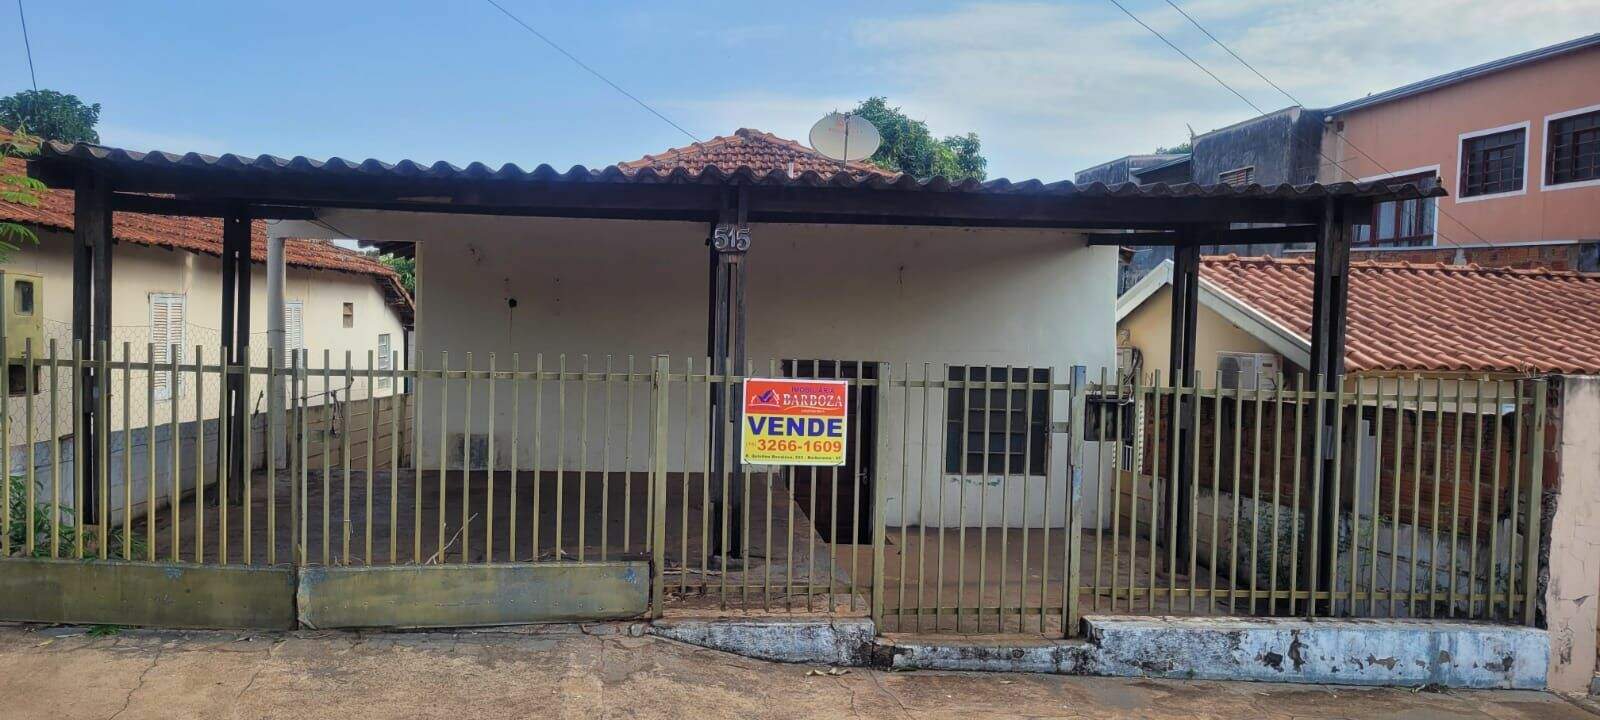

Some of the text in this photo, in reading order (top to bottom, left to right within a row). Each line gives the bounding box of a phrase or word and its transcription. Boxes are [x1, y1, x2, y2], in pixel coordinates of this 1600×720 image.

[714, 225, 751, 251] 515
[783, 394, 842, 407] BARBOZA
[748, 416, 843, 437] VENDE
[757, 439, 842, 453] 3266-1609
